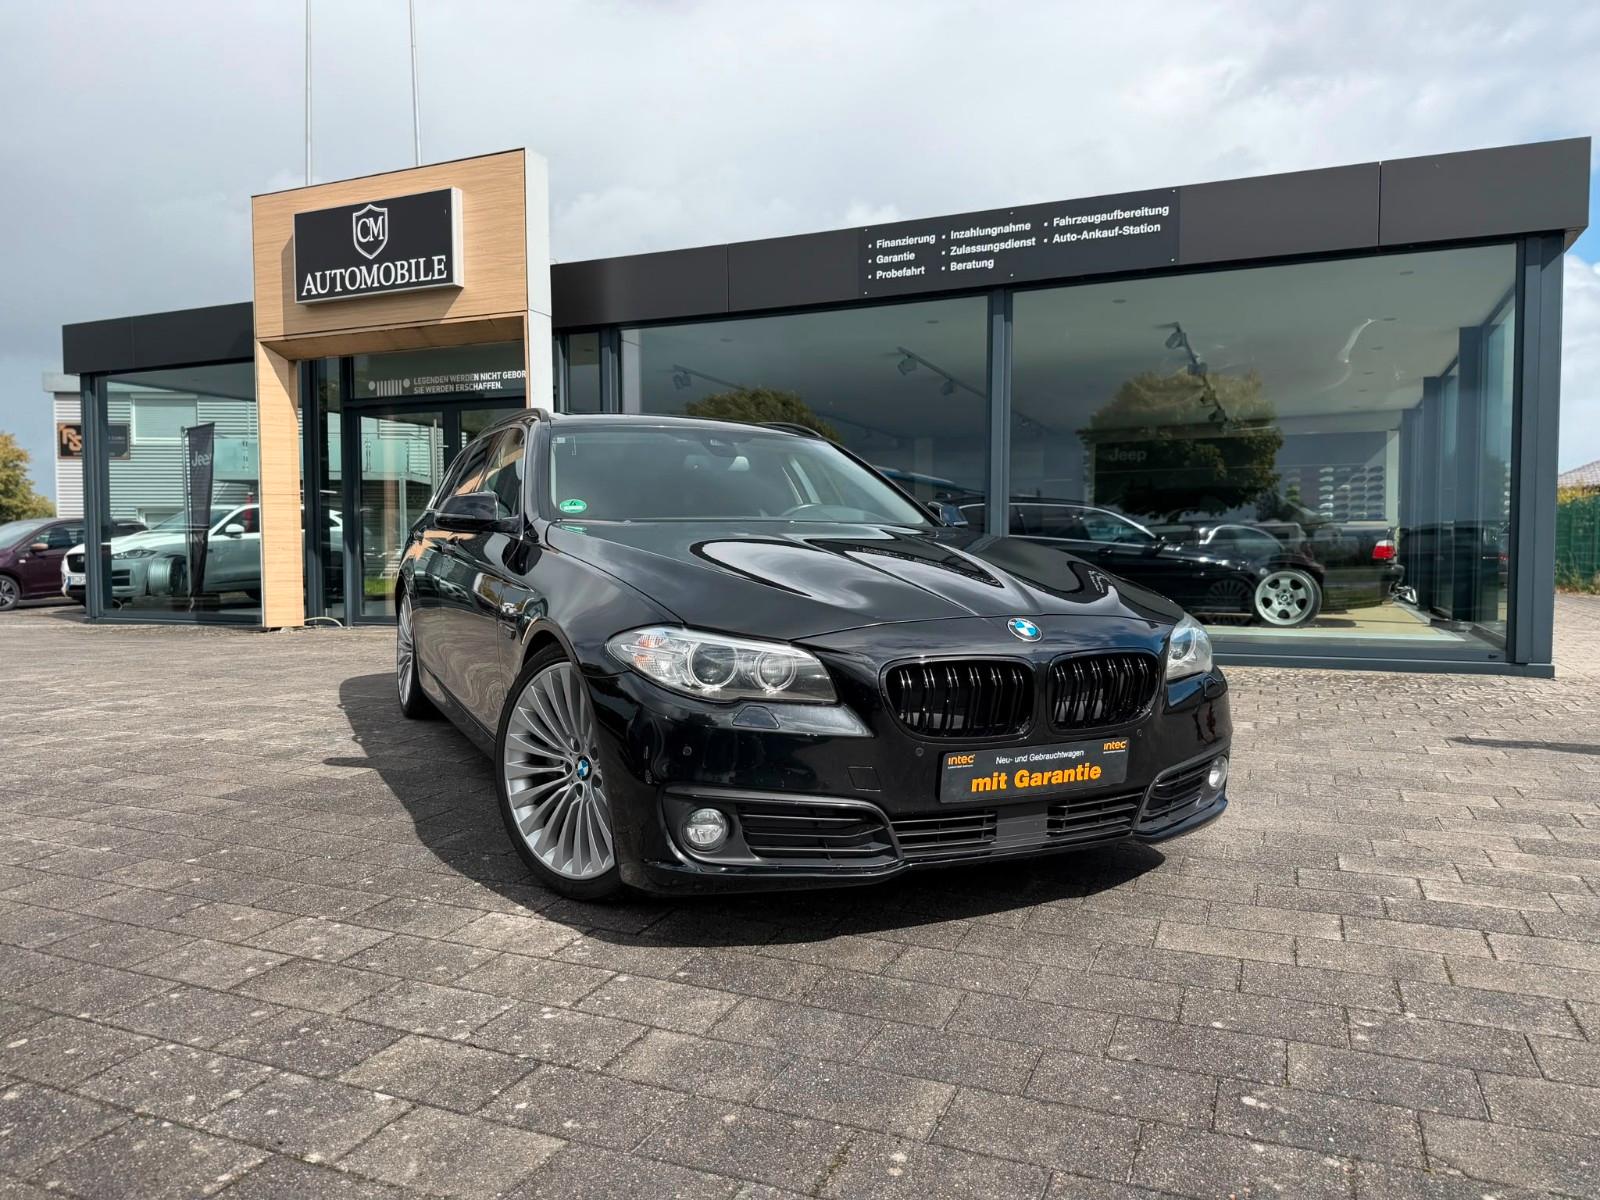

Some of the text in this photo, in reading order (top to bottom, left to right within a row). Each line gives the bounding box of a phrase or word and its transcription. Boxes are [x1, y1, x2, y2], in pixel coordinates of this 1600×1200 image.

[1053, 205, 1169, 227] Fahrzeugaufbereitung
[357, 216, 384, 243] CM
[950, 222, 1031, 240] Inzahlungnahme
[1052, 223, 1161, 243] Auto-Ankauf-Station
[876, 234, 936, 249] Finanzierung
[949, 236, 1036, 256] Zulassungsdienst
[876, 250, 916, 264] Garantie
[876, 265, 926, 280] Probefahrt
[950, 259, 995, 272] Beratung
[301, 255, 447, 296] AUTOMOBILE
[413, 375, 449, 385] LEGENDEN
[450, 373, 480, 383] WERDEN
[480, 371, 502, 381] NICHT
[413, 381, 503, 394] SIE WERDEN ERSCHAFFEN.
[1108, 448, 1147, 463] Jeep
[1103, 740, 1127, 751] intec
[948, 754, 975, 765] intec
[995, 749, 1085, 765] Neu- und Gebrauchtwagen
[971, 762, 1102, 793] mit Garantie
